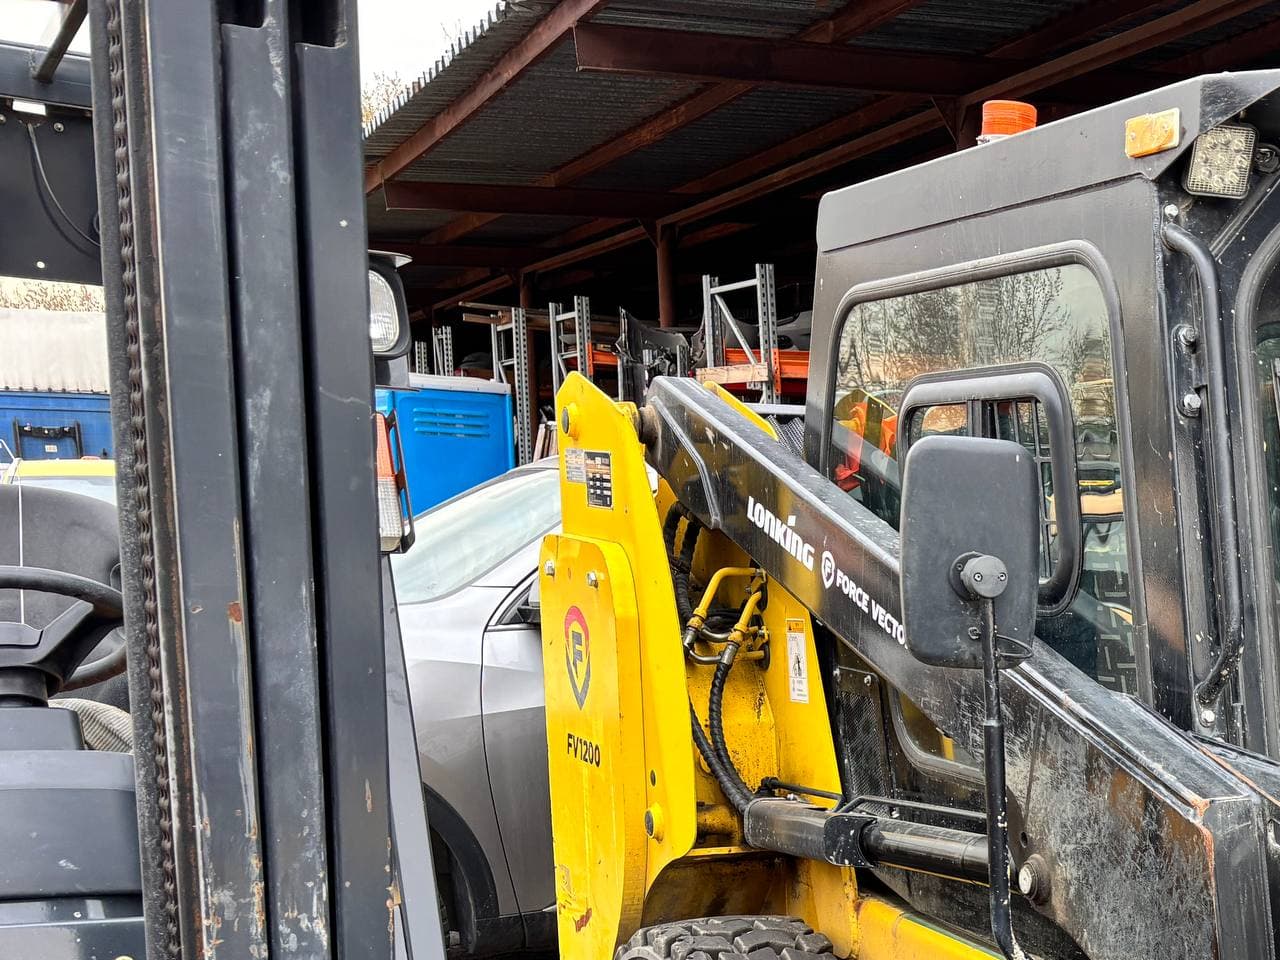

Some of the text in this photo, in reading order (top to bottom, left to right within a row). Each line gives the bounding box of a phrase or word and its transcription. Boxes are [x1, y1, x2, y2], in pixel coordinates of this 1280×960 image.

[836, 568, 869, 614] FORCE
[871, 599, 908, 650] VECTO
[567, 733, 601, 768] FV1200
